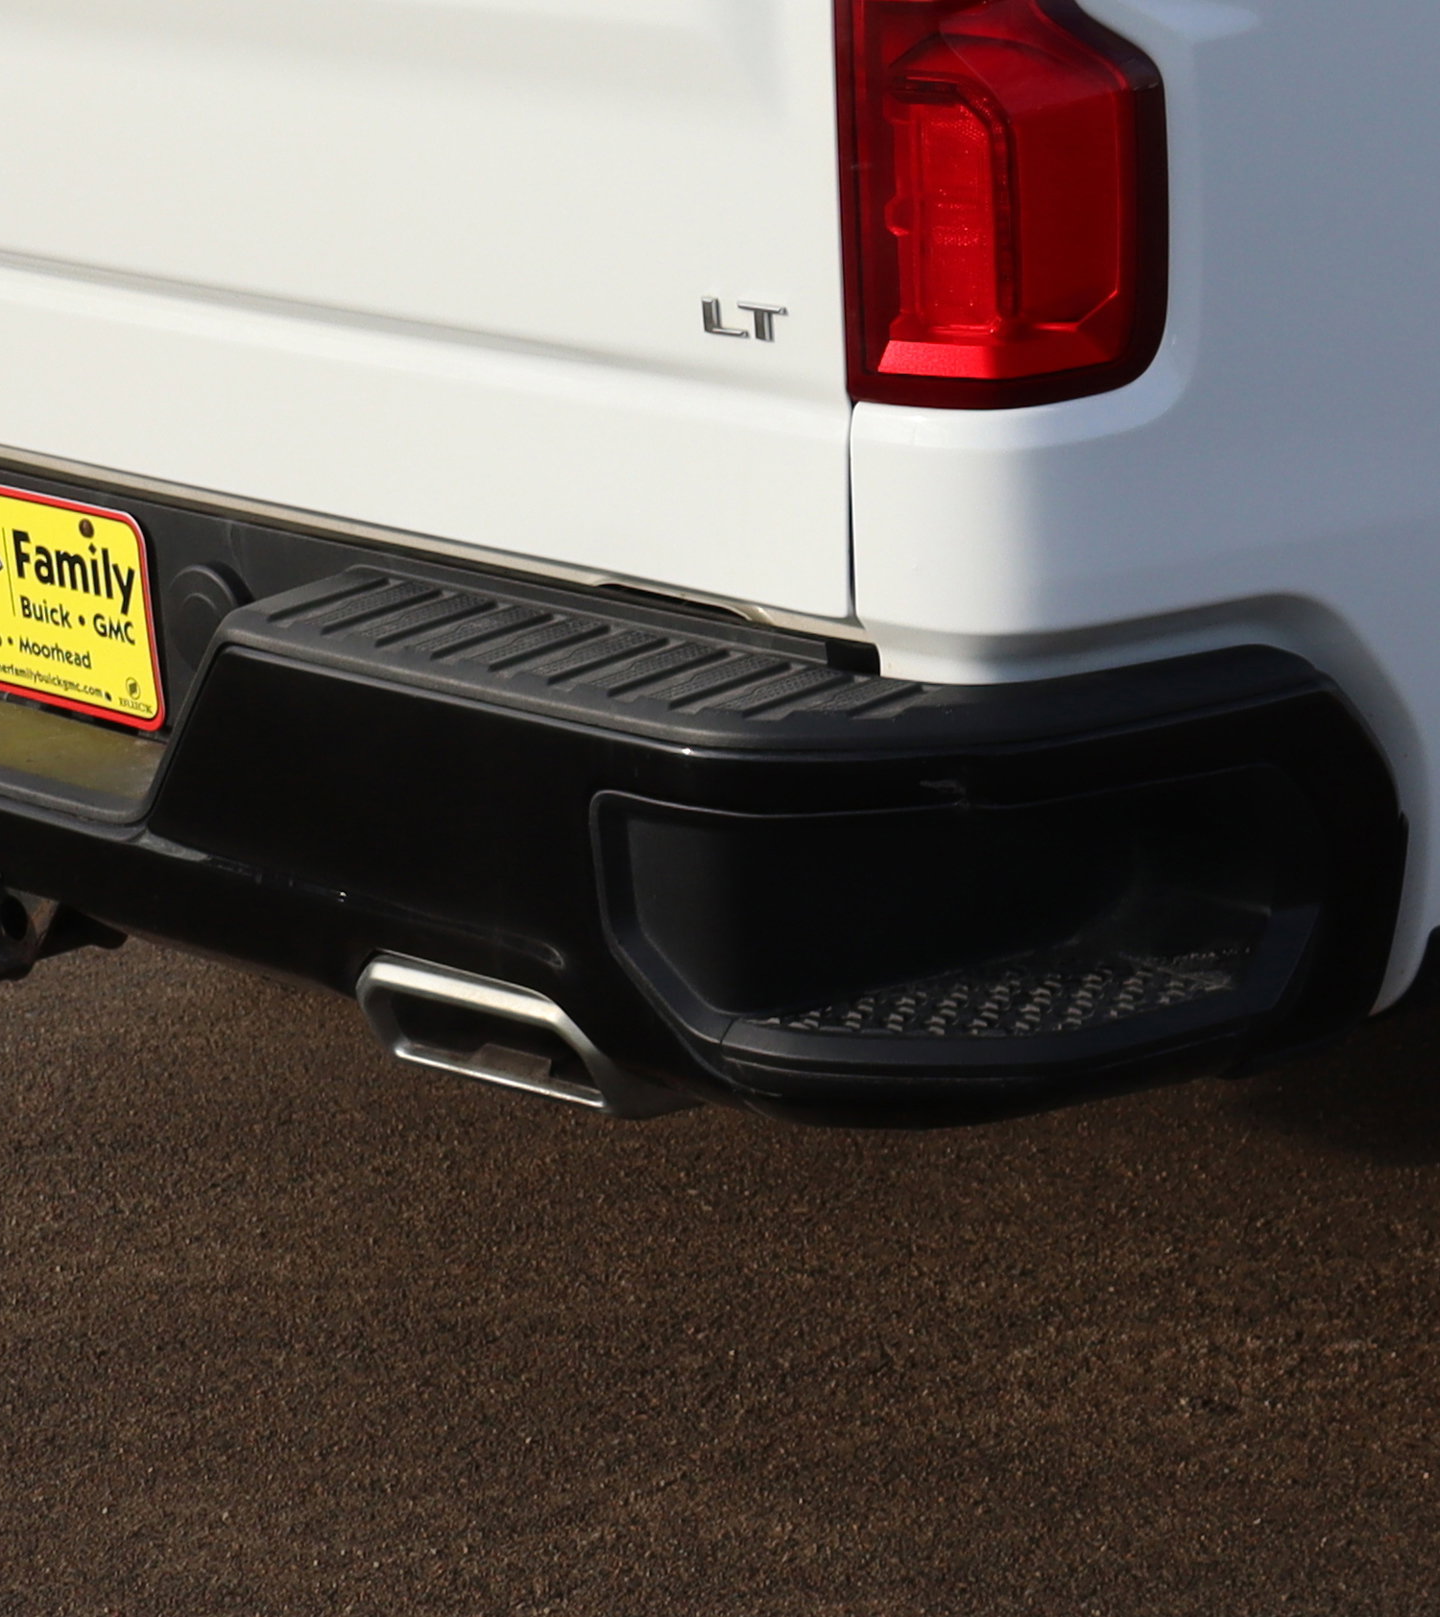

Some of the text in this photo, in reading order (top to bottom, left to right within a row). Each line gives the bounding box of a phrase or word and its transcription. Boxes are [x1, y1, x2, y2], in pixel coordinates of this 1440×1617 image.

[701, 296, 789, 343] LT
[12, 529, 135, 615] Family
[20, 595, 136, 645] Buick GMC
[19, 636, 92, 669] Moorhead
